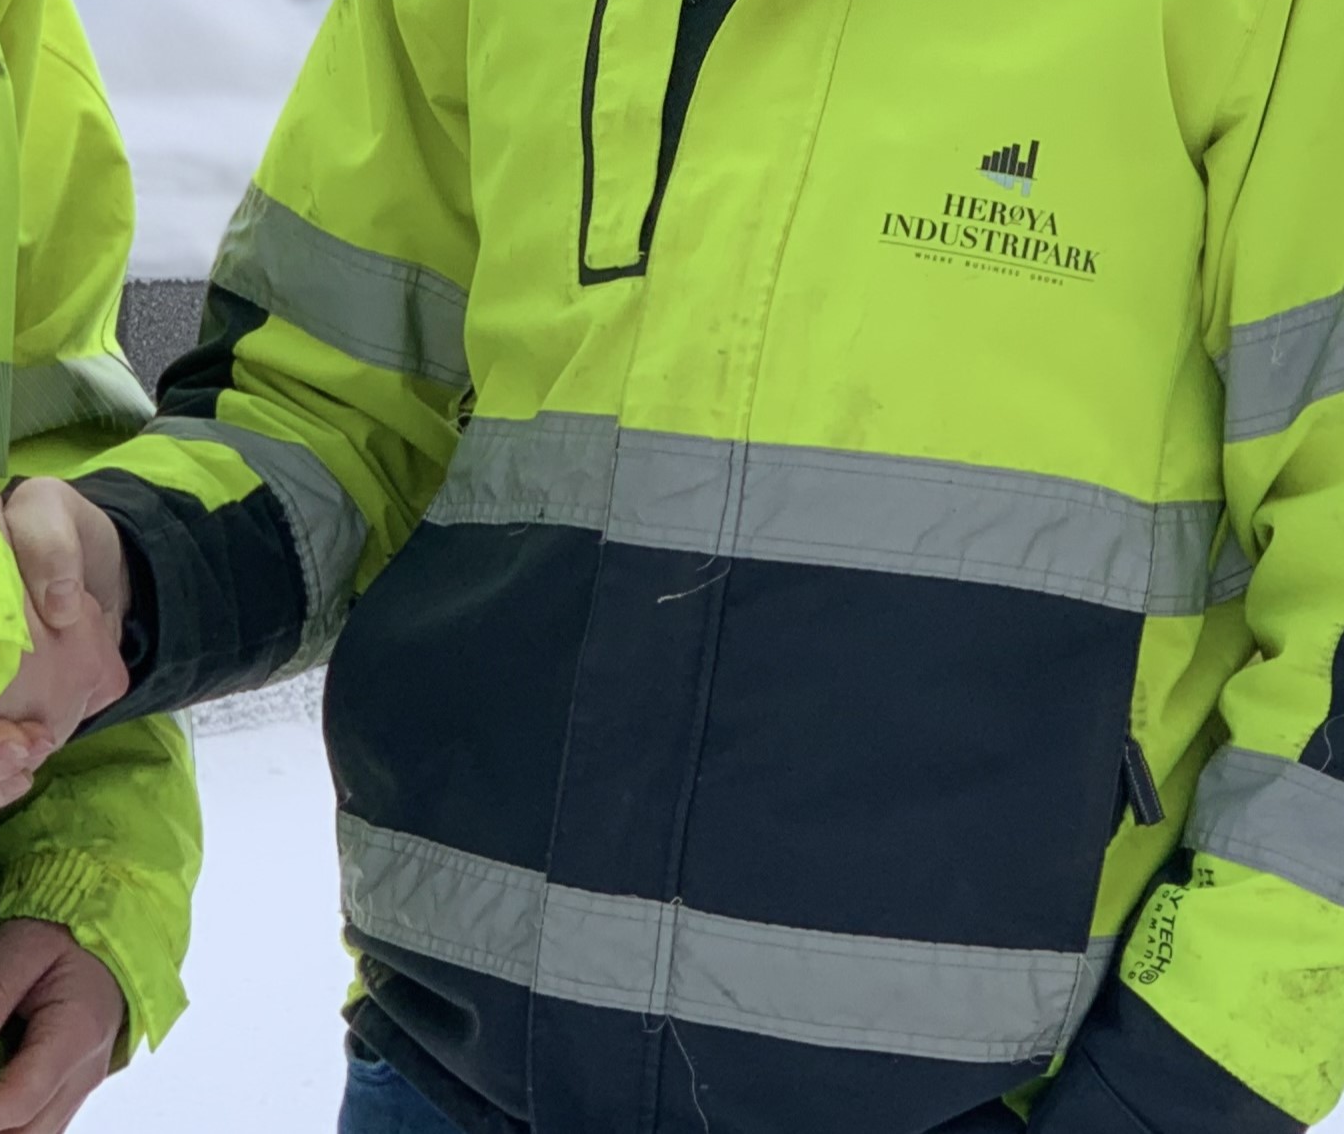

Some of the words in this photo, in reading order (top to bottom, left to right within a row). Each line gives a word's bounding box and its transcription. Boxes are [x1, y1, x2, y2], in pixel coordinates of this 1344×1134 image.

[880, 212, 1101, 274] INDUSTRIPARK
[914, 251, 953, 264] WHERE
[965, 260, 1020, 277] BUSINESS
